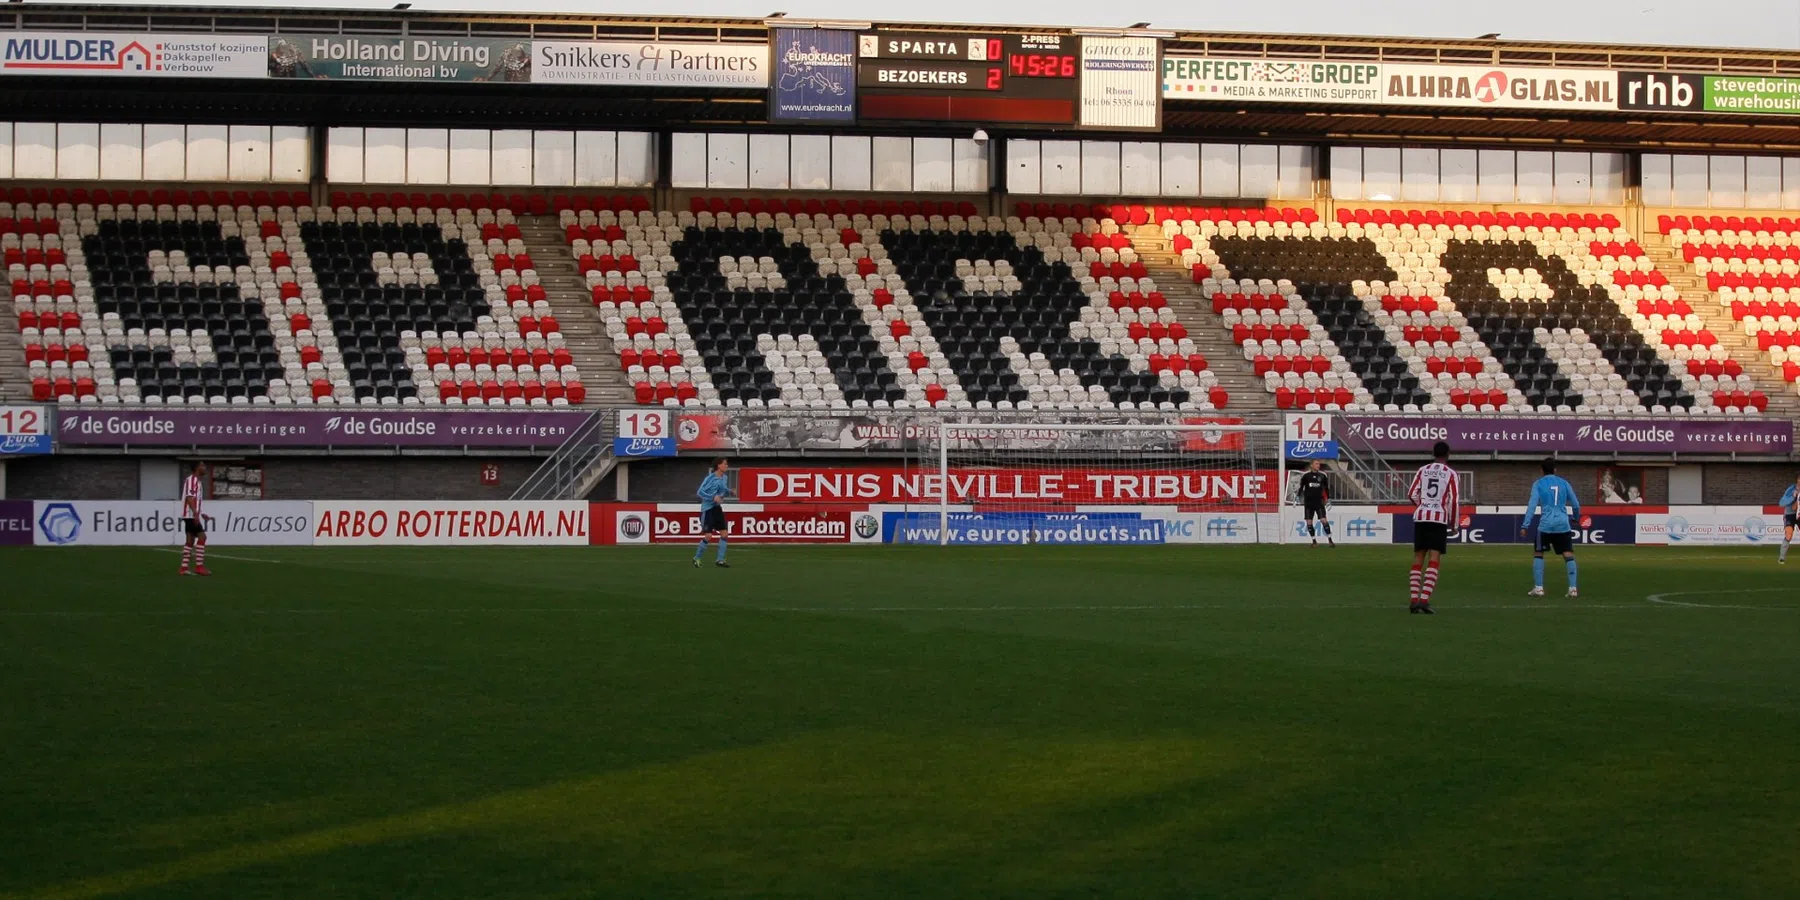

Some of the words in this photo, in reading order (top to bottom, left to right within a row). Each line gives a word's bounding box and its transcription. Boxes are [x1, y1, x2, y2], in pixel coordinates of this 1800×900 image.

[164, 42, 216, 51] Kunststof
[220, 43, 266, 54] kozijnen
[1021, 35, 1061, 44] Z-PRESS
[5, 39, 115, 61] MULDER
[164, 53, 231, 63] Dakkapellen
[312, 38, 404, 61] Holland
[413, 42, 490, 68] Diving
[541, 46, 631, 69] Snikkers
[669, 49, 758, 72] Partners
[789, 53, 852, 62] EUROKRACHT
[889, 41, 957, 55] SPARTA
[988, 39, 1002, 60] 0
[164, 63, 214, 72] Verbouw
[343, 63, 436, 78] International
[440, 65, 459, 79] bv
[1011, 54, 1075, 77] 45:26
[1163, 59, 1252, 81] PERFECT
[1311, 64, 1378, 85] GROEP
[541, 71, 624, 80] ADMINISTRATIE-
[628, 72, 642, 81] EN
[646, 73, 757, 83] BELASTINGADVISEURS
[878, 69, 967, 84] BEZOEKERS
[987, 68, 1001, 89] 2
[1106, 86, 1133, 95] Rhoon
[1223, 85, 1255, 97] MEDIA
[1258, 86, 1266, 97] &
[1268, 86, 1327, 99] MARKETING
[1331, 88, 1377, 100] SUPPORT
[1511, 78, 1614, 103] GLAS.NL
[1628, 74, 1694, 107] rhb
[781, 104, 852, 112] www.eurokracht.nl
[1100, 98, 1111, 106] 06
[1, 409, 38, 434] 12
[81, 416, 103, 434] de
[107, 416, 175, 435] Goudse
[190, 424, 306, 437] verzekeringen
[344, 417, 366, 435] de
[369, 417, 436, 436] Goudse
[451, 424, 566, 438] verzekeringen
[625, 413, 662, 437] 13
[1292, 417, 1326, 440] 14
[857, 426, 899, 439] WALL
[1020, 429, 1059, 440] FANS
[1365, 423, 1384, 440] de
[1387, 422, 1448, 440] Goudse
[1461, 430, 1565, 443] verzekeringen
[1593, 425, 1613, 442] de
[1616, 425, 1675, 443] Goudse
[1687, 432, 1787, 444] verzekeringen
[630, 438, 661, 450] Euro
[1296, 441, 1325, 452] Euro
[483, 469, 497, 481] 13
[756, 473, 881, 498] DENIS
[1426, 478, 1439, 499] 5
[1550, 485, 1559, 506] 7
[0, 519, 31, 531] TEL
[93, 510, 216, 533] Flandern
[225, 511, 307, 533] Incasso
[316, 510, 388, 538] ARBO
[396, 510, 586, 538] ROTTERDAM.NL
[626, 521, 640, 533] FIAT
[654, 516, 681, 535] De
[688, 516, 735, 535] Br
[742, 516, 846, 535] Rotterdam
[1689, 525, 1713, 535] Group
[1766, 525, 1786, 534] Grou
